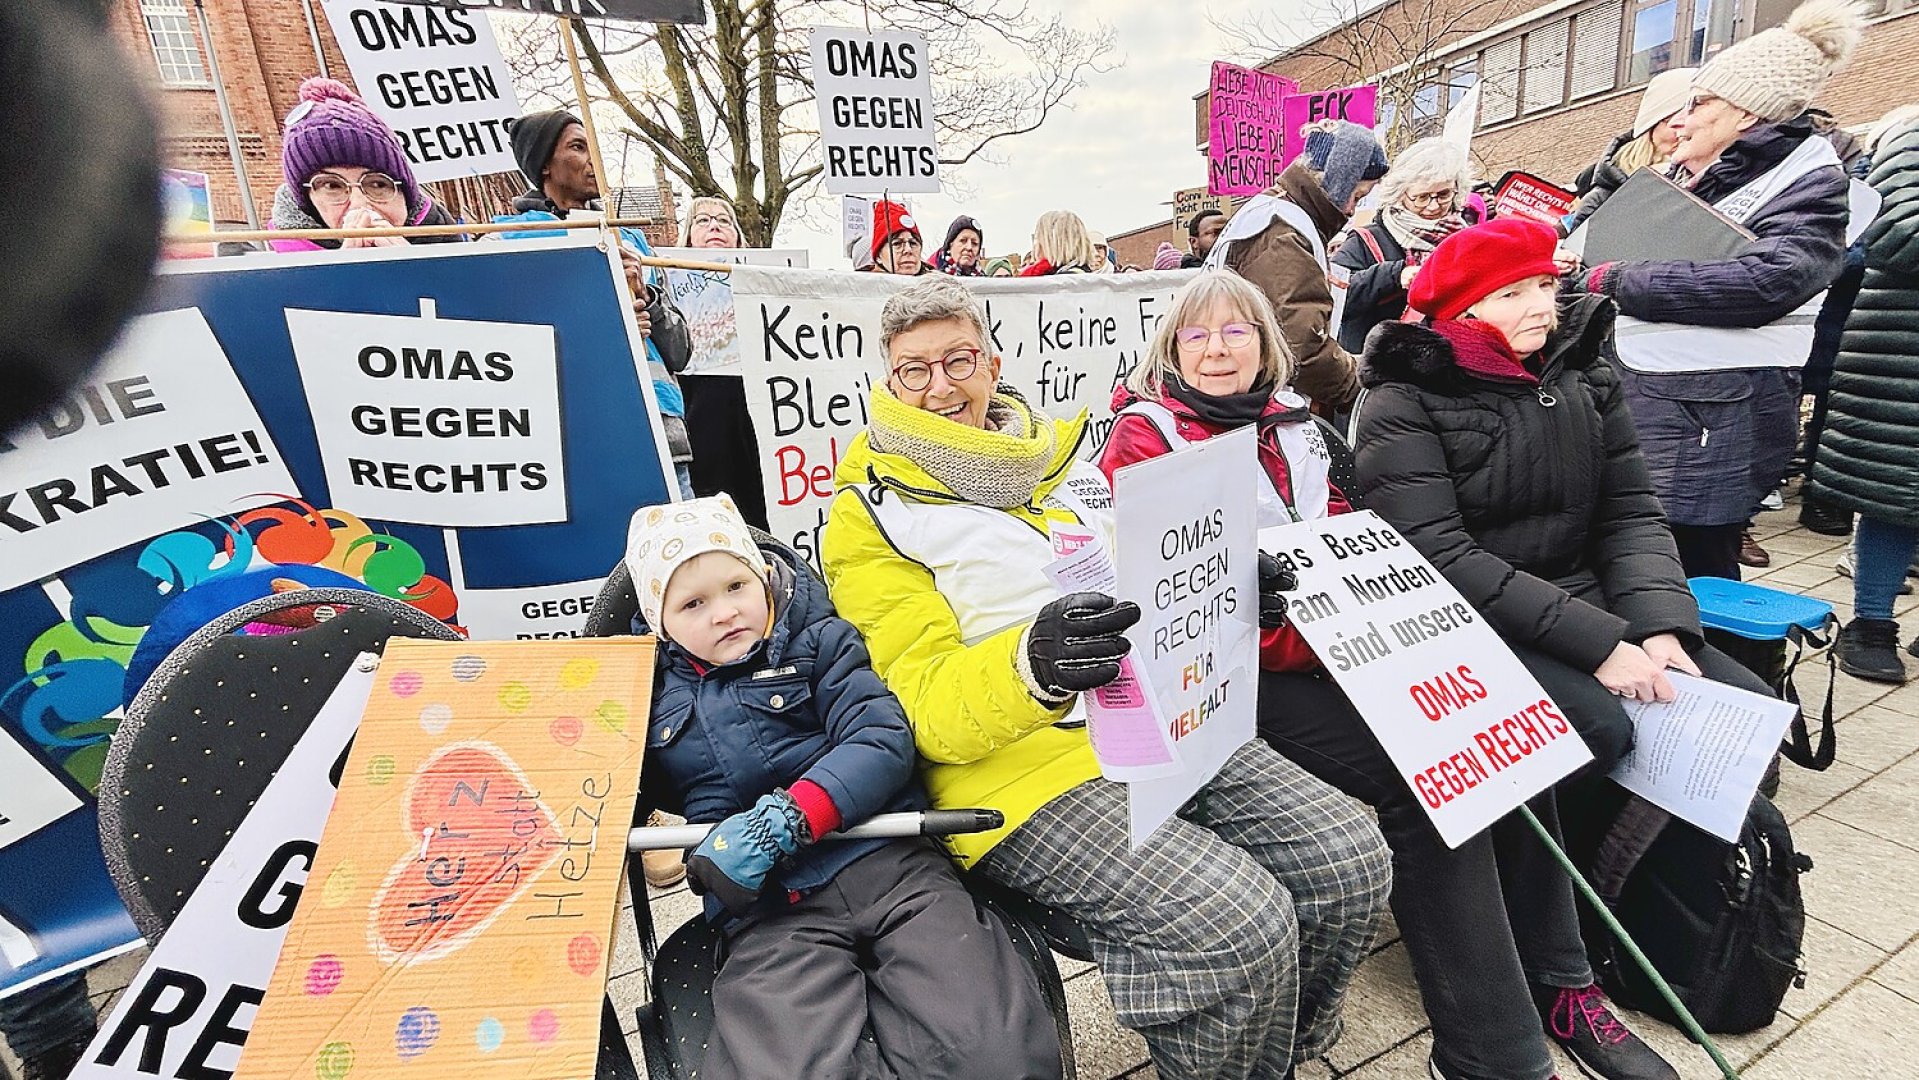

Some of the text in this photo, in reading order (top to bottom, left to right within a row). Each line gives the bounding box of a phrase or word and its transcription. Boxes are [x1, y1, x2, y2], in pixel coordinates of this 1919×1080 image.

[350, 6, 477, 51] OMAS
[826, 39, 918, 79] OMAS
[376, 65, 500, 109] GEGEN
[1216, 66, 1286, 104] LIEBE NICHT
[832, 95, 923, 129] GEGEN
[1220, 118, 1265, 154] LIEBE
[828, 145, 935, 177] RECHTS
[1176, 198, 1220, 214] nicht mit
[761, 303, 863, 361] Kein
[1038, 300, 1116, 354] keine
[357, 345, 514, 382] OMAS
[1035, 360, 1087, 407] für
[351, 405, 531, 438] GEGEN
[348, 457, 548, 493] RECHTS
[1067, 479, 1102, 487] OMAS
[1161, 508, 1223, 561] OMAS
[1259, 527, 1401, 572] as Beste
[1154, 547, 1229, 611] GEGEN
[1291, 563, 1437, 624] am Norden
[1154, 586, 1237, 660] RECHTS
[1328, 601, 1474, 672] sind unsere
[1183, 651, 1213, 691] FÜR
[1410, 665, 1487, 721] OMAS
[1414, 747, 1489, 809] GEGEN
[1474, 699, 1568, 773] RECHTS
[526, 772, 612, 921] Hetze
